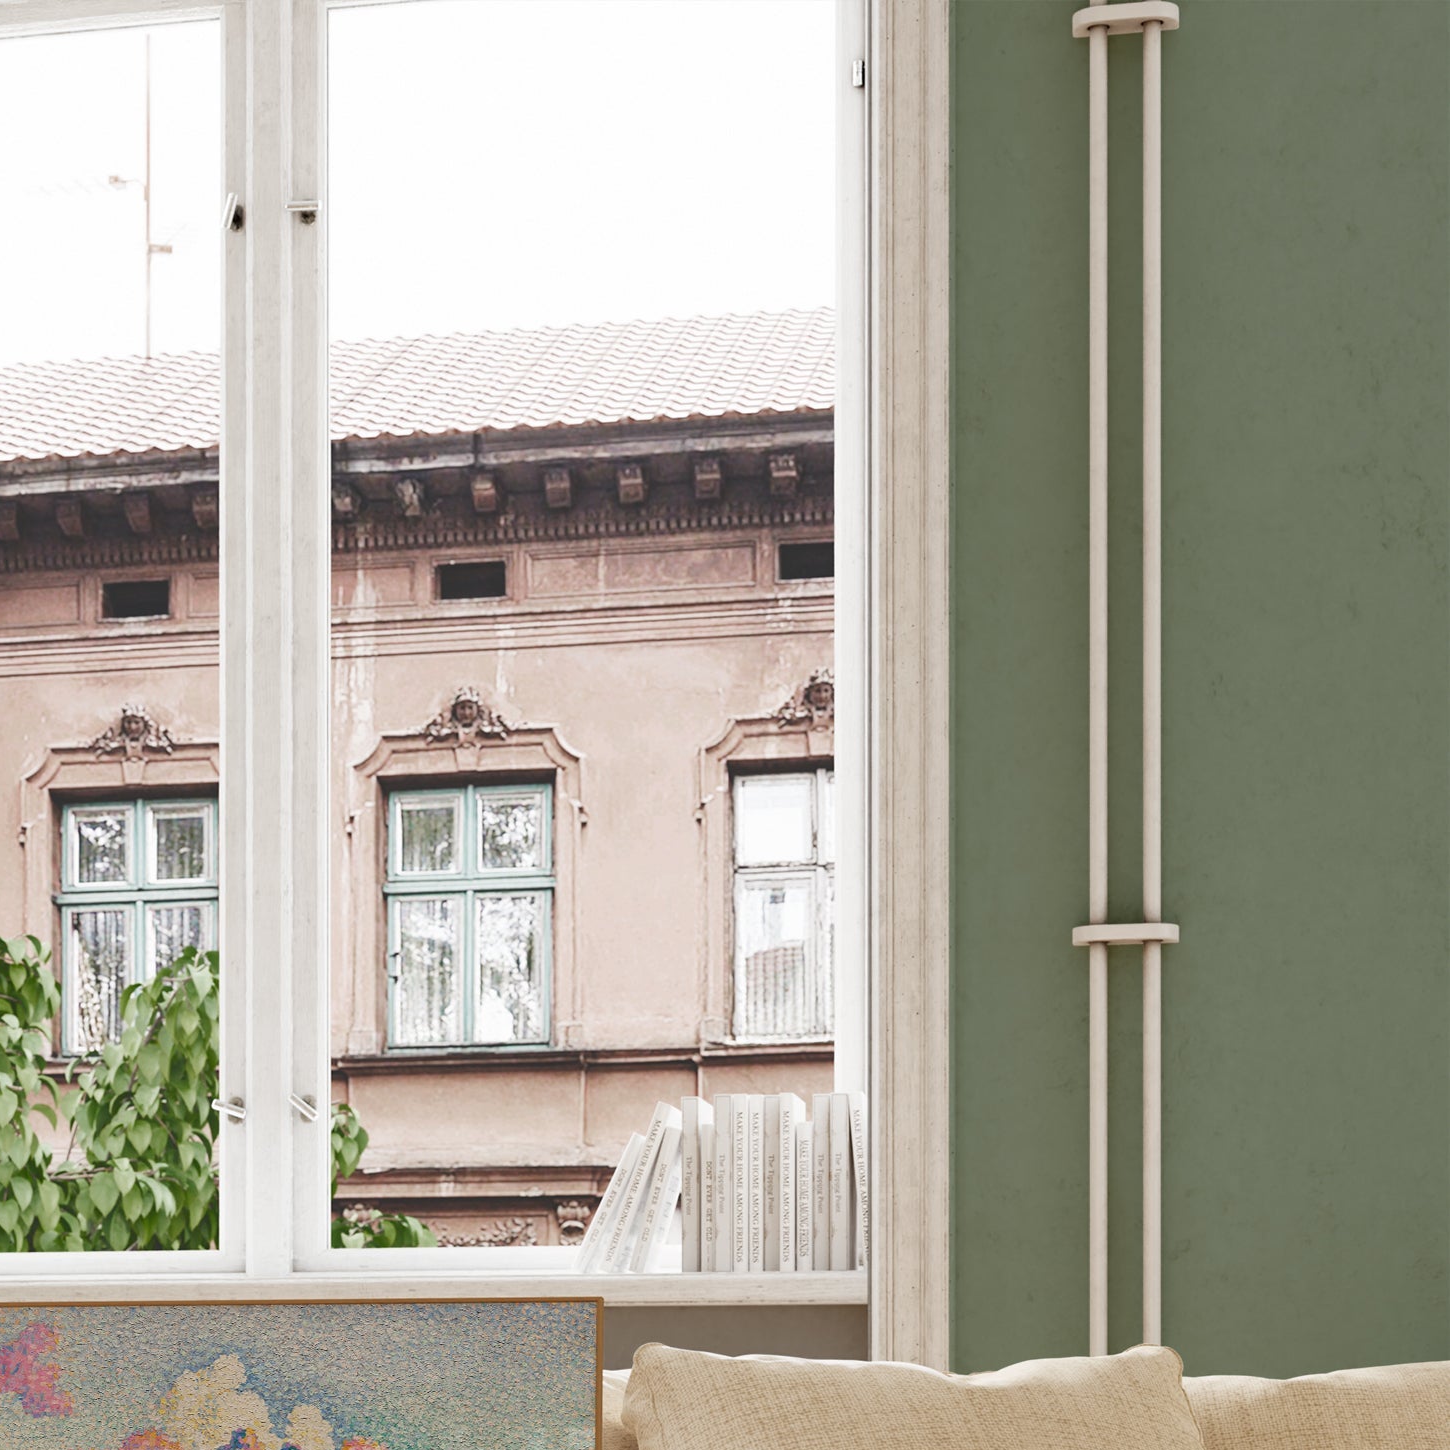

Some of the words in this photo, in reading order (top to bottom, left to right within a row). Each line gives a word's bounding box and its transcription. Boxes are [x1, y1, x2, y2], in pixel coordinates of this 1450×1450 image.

[648, 1119, 662, 1143] MAKE
[736, 1111, 744, 1135] MAKE
[752, 1112, 760, 1136] MAKE
[782, 1110, 790, 1135] MAKE
[853, 1109, 862, 1133] MAKE
[638, 1144, 655, 1168] YOUR
[717, 1153, 726, 1167] The
[736, 1137, 744, 1162] YOUR
[752, 1138, 760, 1162] YOUR
[782, 1137, 790, 1160] YOUR
[855, 1135, 864, 1160] YOUR
[684, 1156, 693, 1169] The
[766, 1154, 775, 1168] The
[816, 1154, 824, 1167] The
[629, 1168, 645, 1193] HOME
[684, 1171, 693, 1196] Tipping
[717, 1170, 726, 1195] Tipping
[736, 1163, 744, 1190] HOME
[752, 1164, 760, 1190] HOME
[766, 1170, 775, 1195] Tipping
[782, 1162, 790, 1188] HOME
[816, 1169, 824, 1195] Tipping
[857, 1161, 866, 1188] HOME
[617, 1195, 636, 1226] AMONG
[684, 1198, 693, 1216] Point
[717, 1196, 726, 1214] Point
[736, 1192, 744, 1225] AMONG
[752, 1192, 760, 1225] AMONG
[766, 1197, 775, 1214] Point
[782, 1190, 790, 1224] AMONG
[816, 1196, 824, 1214] Point
[604, 1227, 624, 1263] FRIENDS
[736, 1226, 744, 1263] FRIENDS
[752, 1227, 760, 1263] FRIENDS
[782, 1226, 790, 1263] FRIENDS
